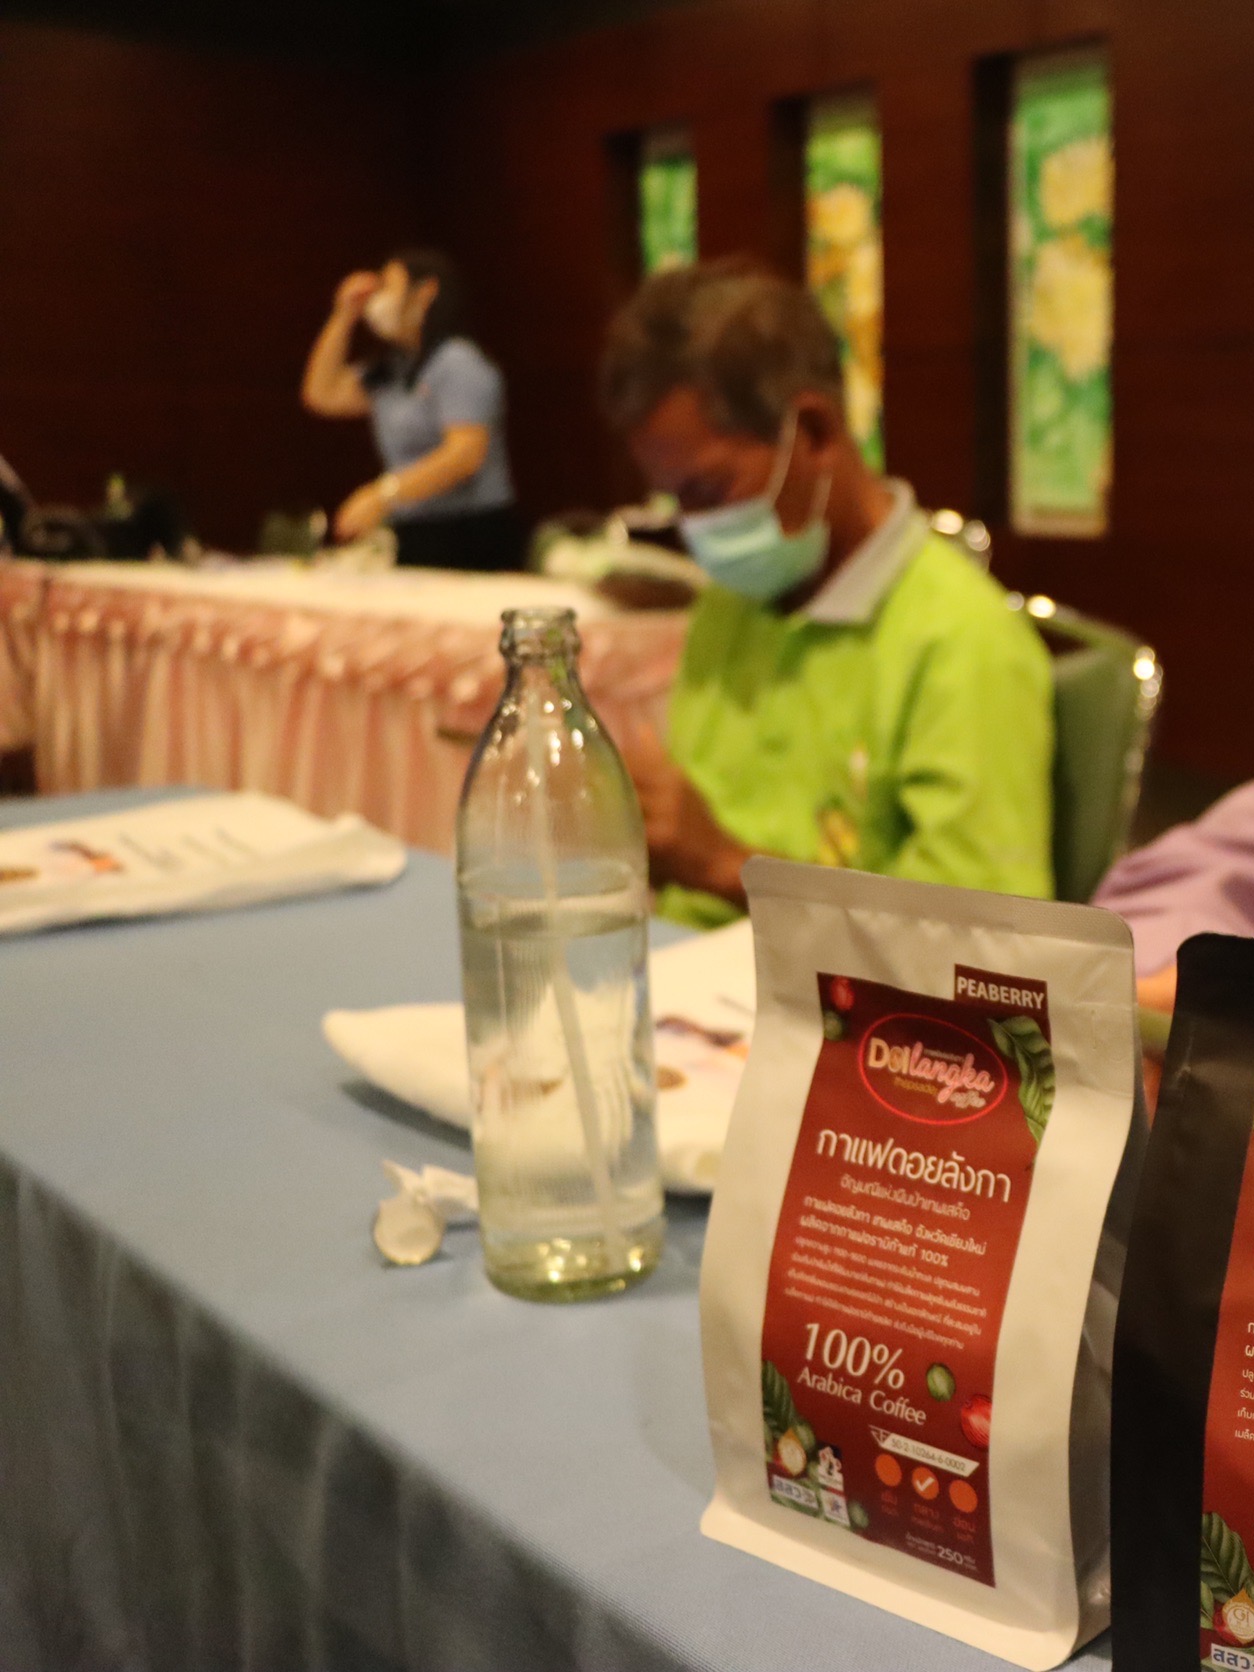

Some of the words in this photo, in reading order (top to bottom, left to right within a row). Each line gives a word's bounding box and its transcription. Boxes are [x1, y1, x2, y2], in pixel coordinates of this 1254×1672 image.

[957, 976, 1045, 1010] PEABERRY
[816, 1128, 1011, 1203] กาแฟดอยลังกา
[921, 1249, 949, 1267] 100%
[804, 1323, 905, 1390] 100%
[797, 1366, 862, 1404] Arabica
[869, 1390, 927, 1426] Coffee
[937, 1545, 963, 1564] 250
